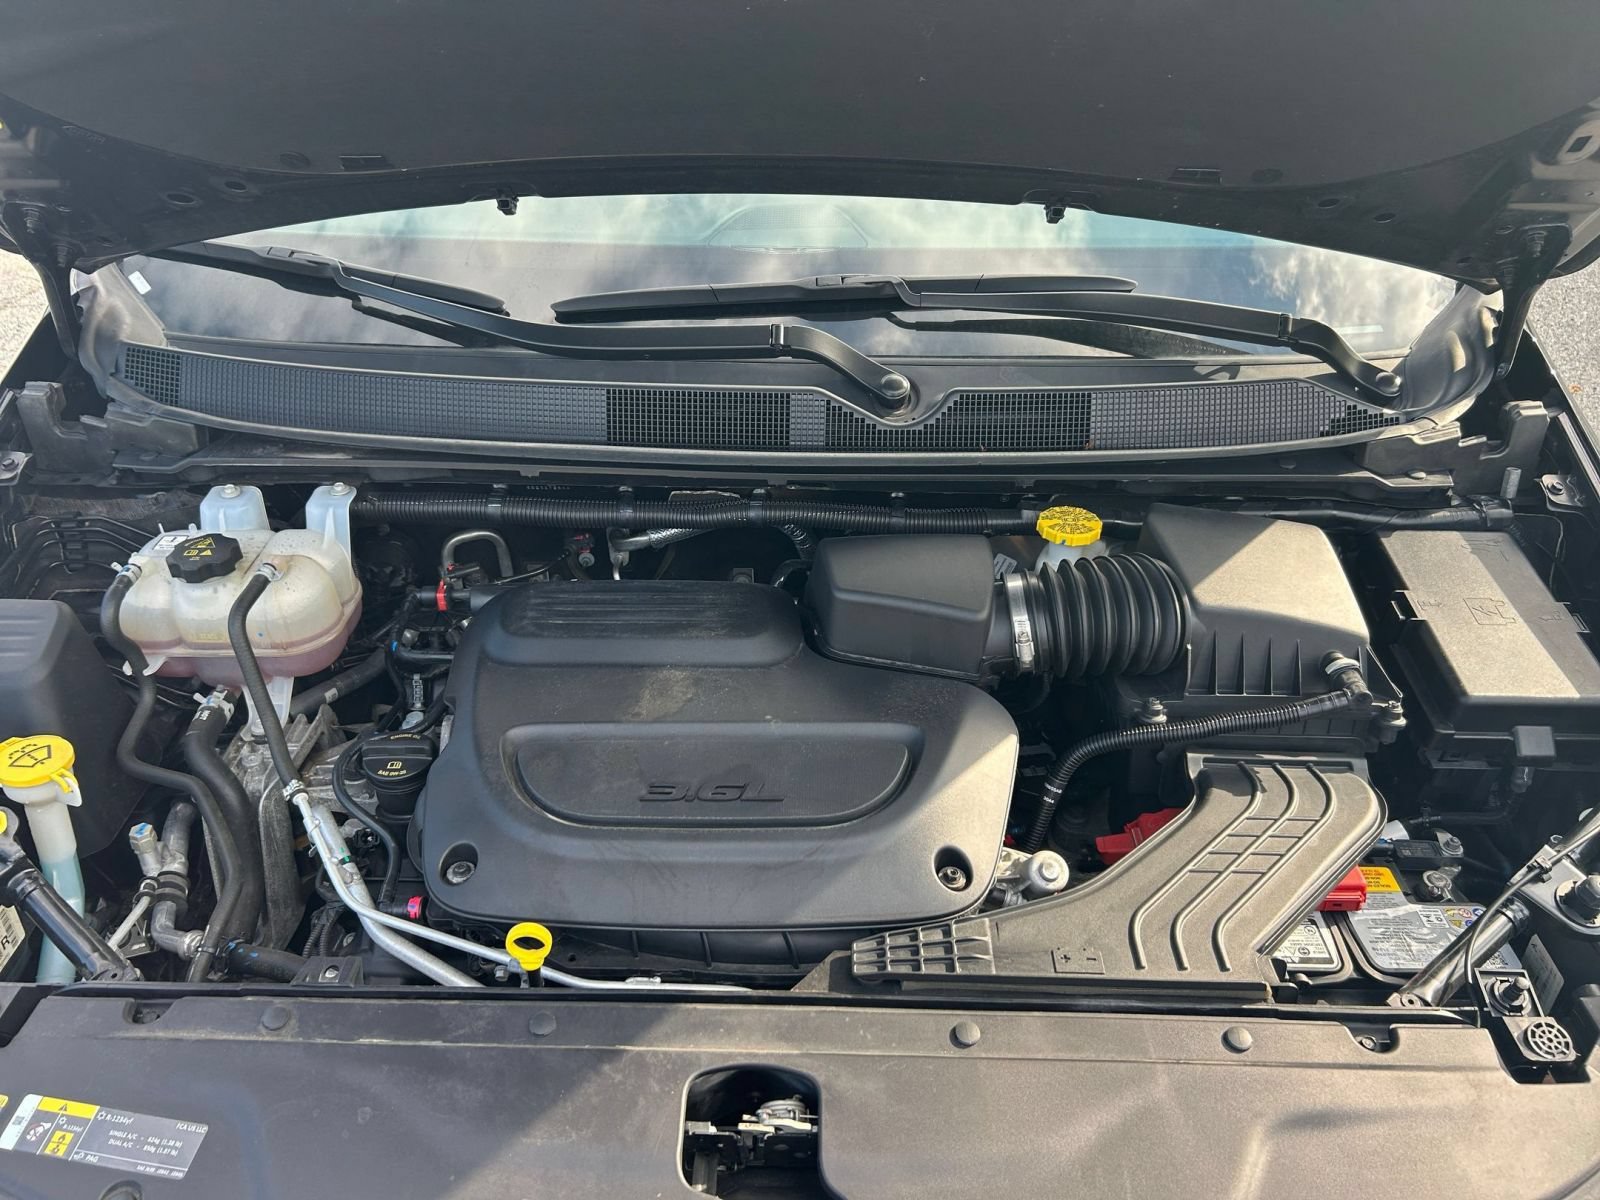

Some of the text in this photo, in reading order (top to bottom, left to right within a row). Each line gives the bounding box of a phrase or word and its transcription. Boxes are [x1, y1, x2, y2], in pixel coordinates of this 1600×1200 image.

[638, 781, 785, 803] 3.6L
[106, 1113, 134, 1126] R-1234yf
[85, 1154, 99, 1163] PAG
